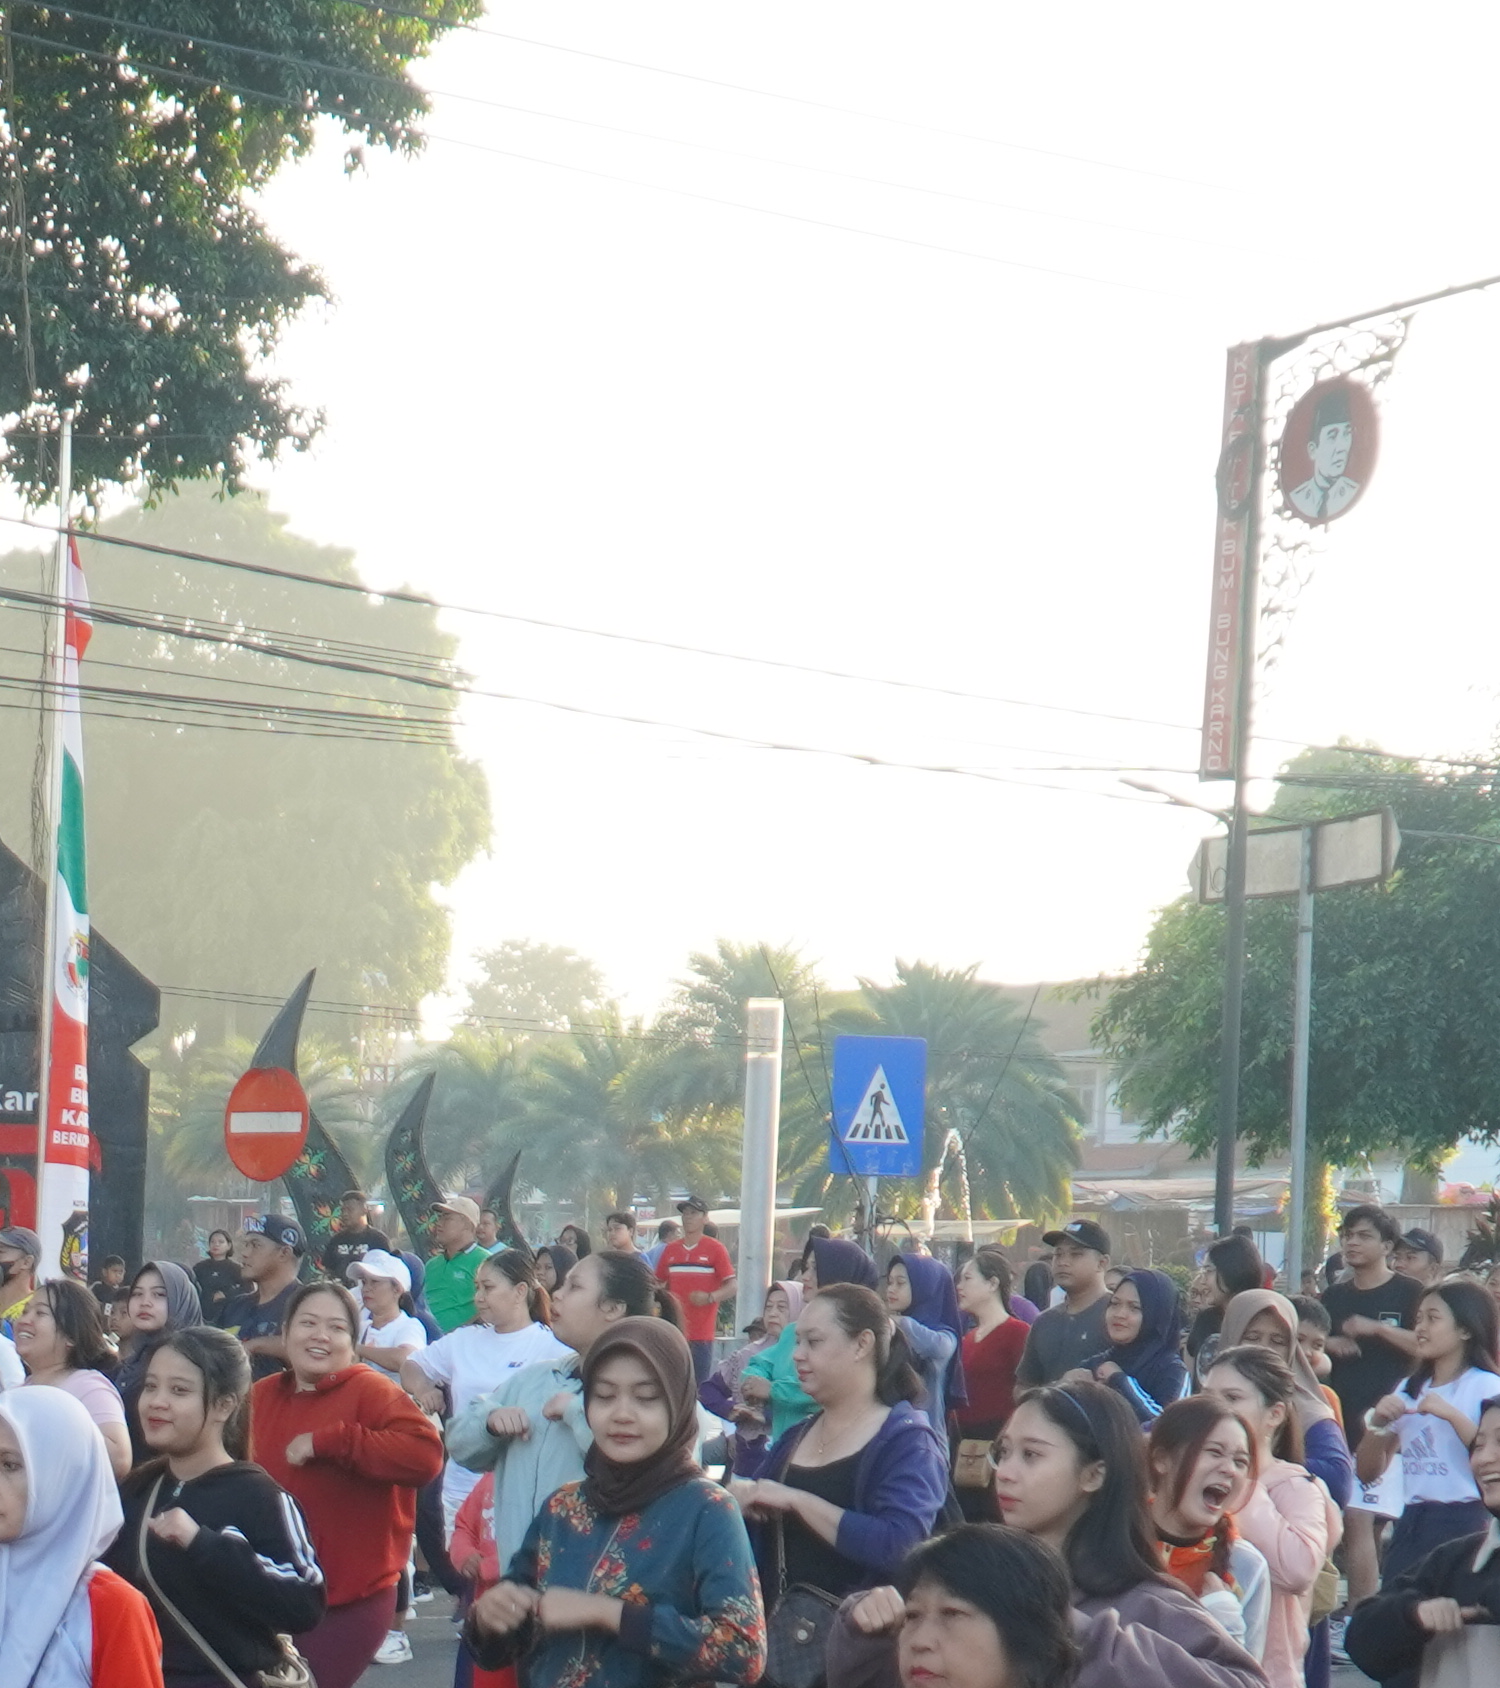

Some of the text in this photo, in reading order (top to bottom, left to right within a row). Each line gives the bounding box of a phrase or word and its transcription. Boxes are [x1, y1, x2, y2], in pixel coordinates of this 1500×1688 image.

[1219, 540, 1236, 606] BUMI
[1213, 613, 1232, 680] BUNG
[1207, 688, 1226, 771] KARNO
